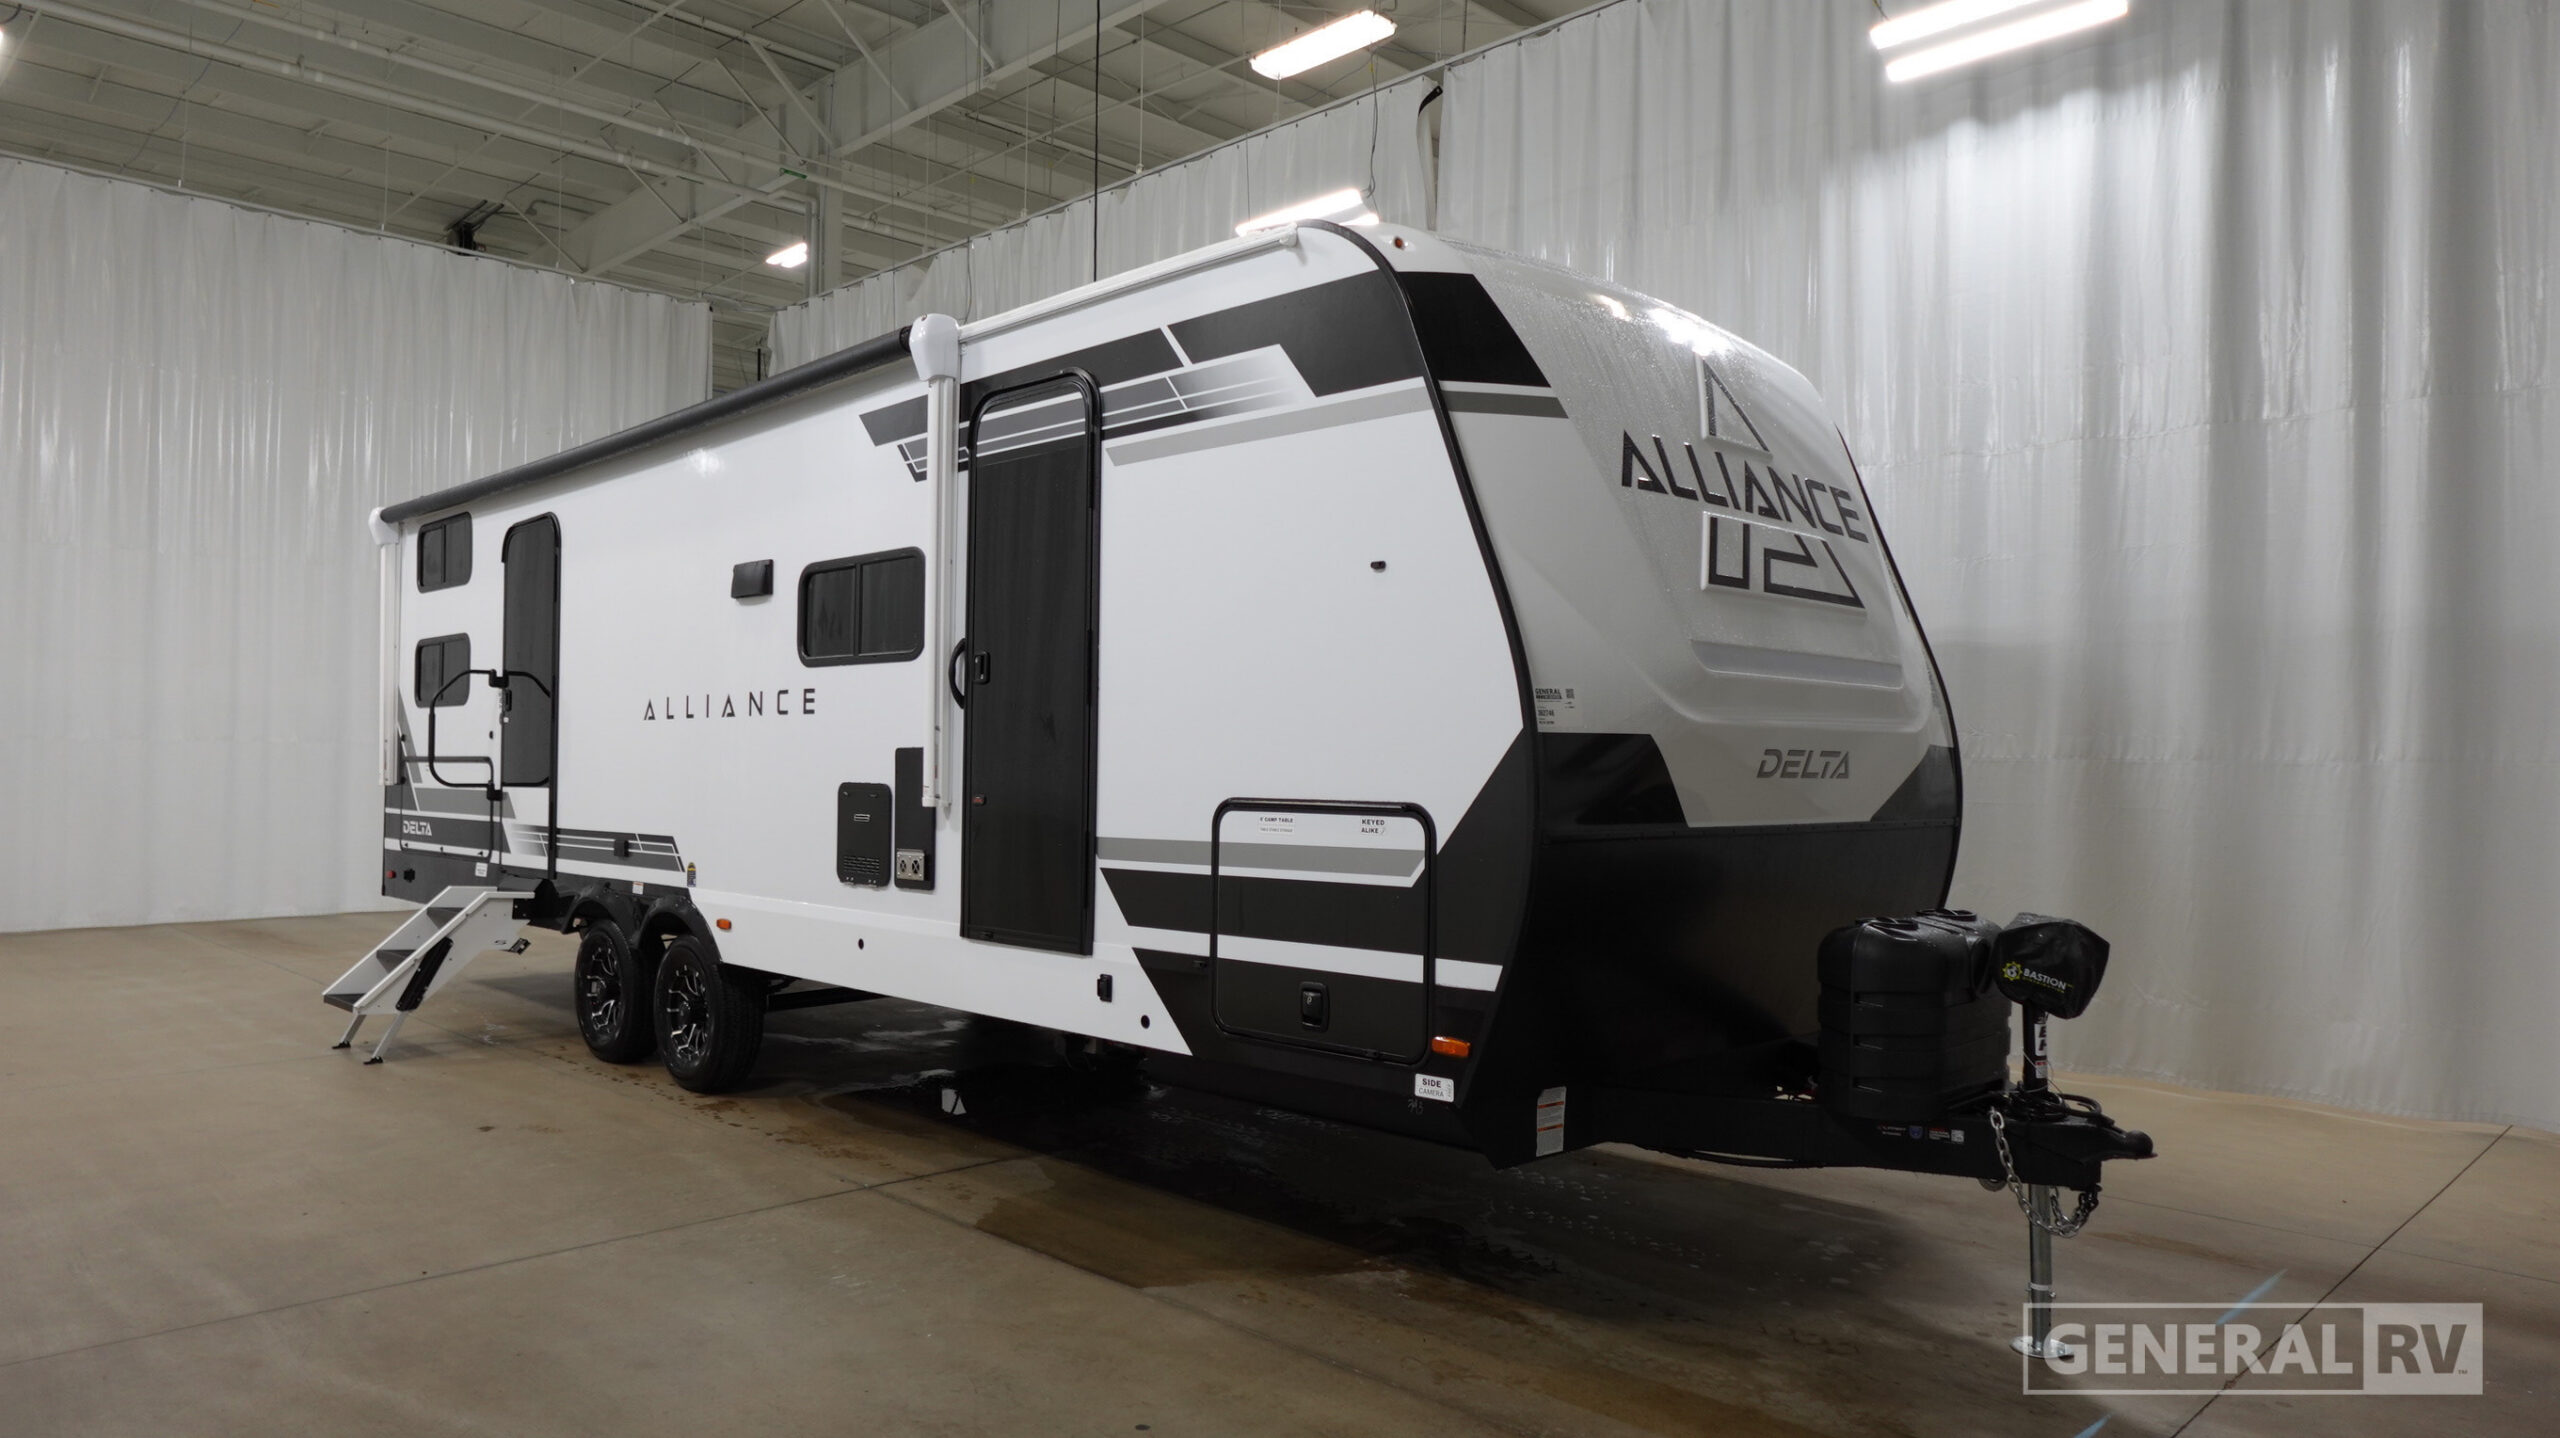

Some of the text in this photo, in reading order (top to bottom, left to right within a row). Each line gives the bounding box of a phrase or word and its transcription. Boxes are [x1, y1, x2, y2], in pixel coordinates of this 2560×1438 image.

[1621, 429, 1869, 544] ALLIANCE
[643, 688, 816, 721] ALLIANCE
[1756, 748, 1851, 780] DELTA
[402, 820, 433, 837] DELTA
[1361, 818, 1385, 826] KEYED
[2023, 968, 2067, 990] BASTION
[1418, 1087, 1445, 1097] CAMERA
[1422, 1078, 1442, 1089] SIDE
